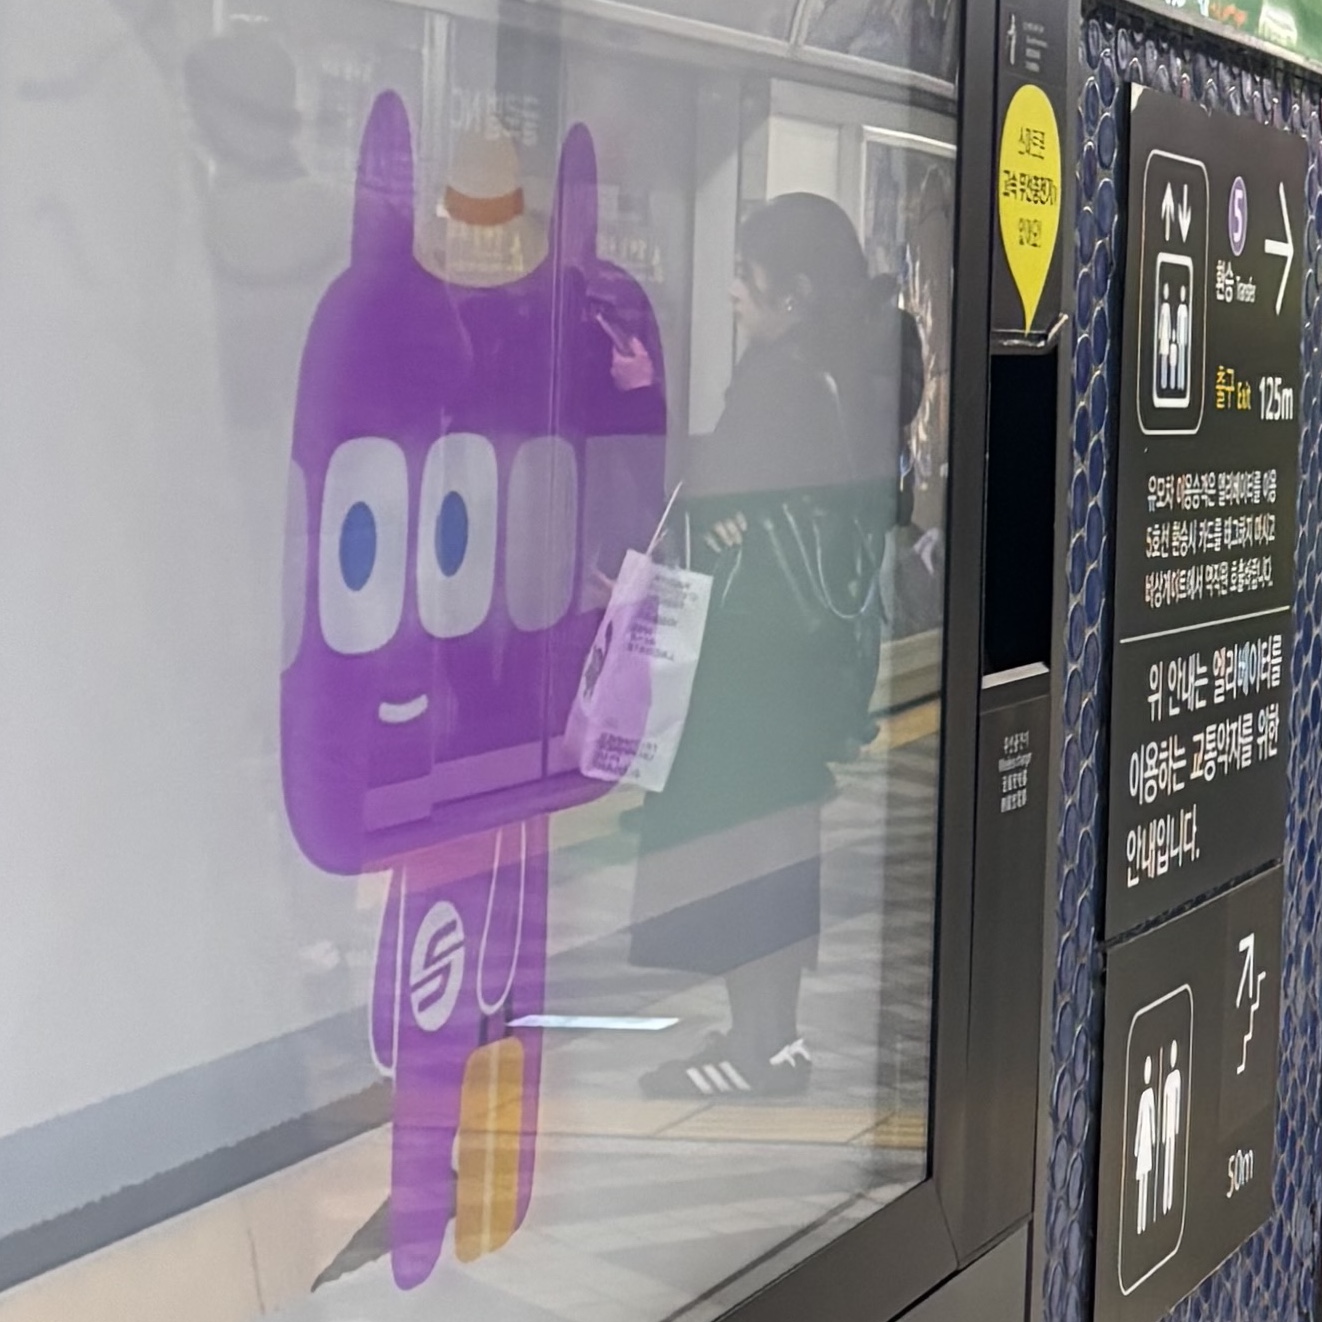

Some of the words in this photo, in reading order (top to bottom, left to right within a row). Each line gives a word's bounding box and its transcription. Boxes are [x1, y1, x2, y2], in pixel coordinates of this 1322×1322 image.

[1002, 169, 1018, 201] 고속
[1233, 188, 1244, 243] 5
[1216, 259, 1234, 303] 환승
[1216, 365, 1234, 409] 출구
[1237, 379, 1251, 410] Exit
[1259, 376, 1293, 420] 125m
[1148, 474, 1174, 512] 유모차
[1176, 472, 1216, 510] 이용승객은
[1218, 470, 1261, 507] 엘리베이터를
[1263, 469, 1277, 503] 이용
[1146, 521, 1170, 558] 5호선
[1172, 519, 1197, 557] 환승시
[1199, 517, 1222, 552] 카드를
[1254, 512, 1275, 545] 마시고
[1145, 564, 1203, 609] 비상게이트에서
[1148, 660, 1163, 722] 위
[1168, 652, 1208, 716] 안내는
[1212, 634, 1283, 704] 엘리베이터를
[1129, 734, 1187, 805] 이용하는
[1190, 712, 1254, 782] 교통약자를
[1257, 702, 1280, 761] 위한
[1127, 803, 1200, 888] 안내입니다.
[1226, 1149, 1254, 1198] 50m
